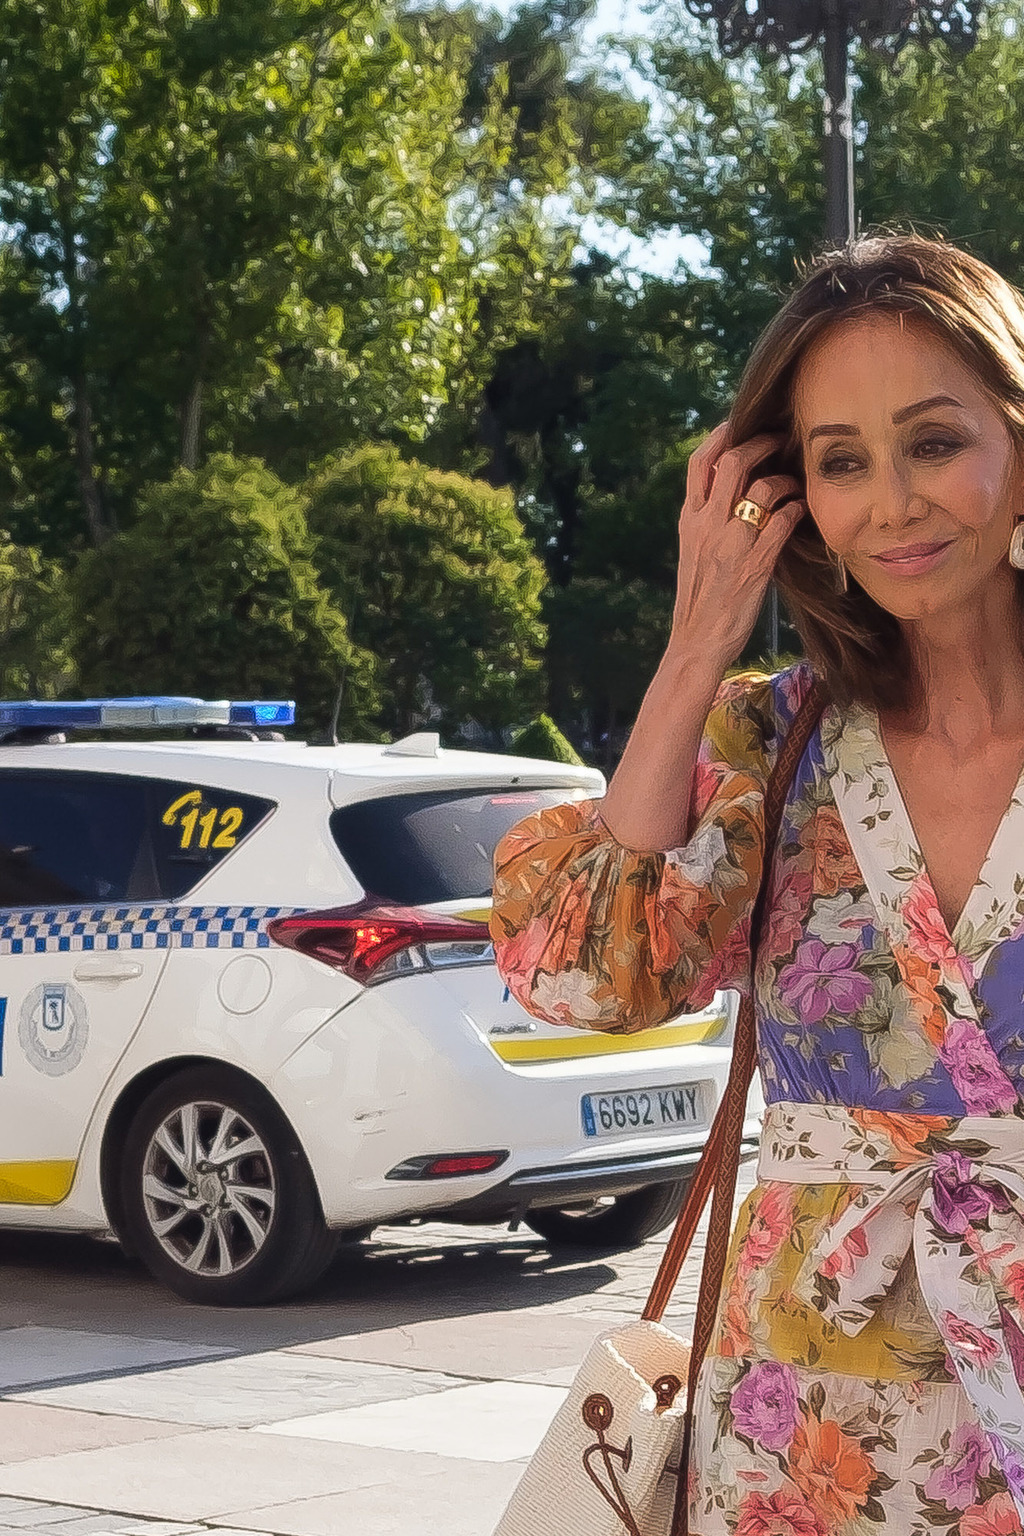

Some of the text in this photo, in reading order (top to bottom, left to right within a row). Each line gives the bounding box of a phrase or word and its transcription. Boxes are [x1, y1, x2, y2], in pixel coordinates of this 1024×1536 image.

[180, 807, 244, 848] 112
[598, 1087, 697, 1130] 6692 KWY
